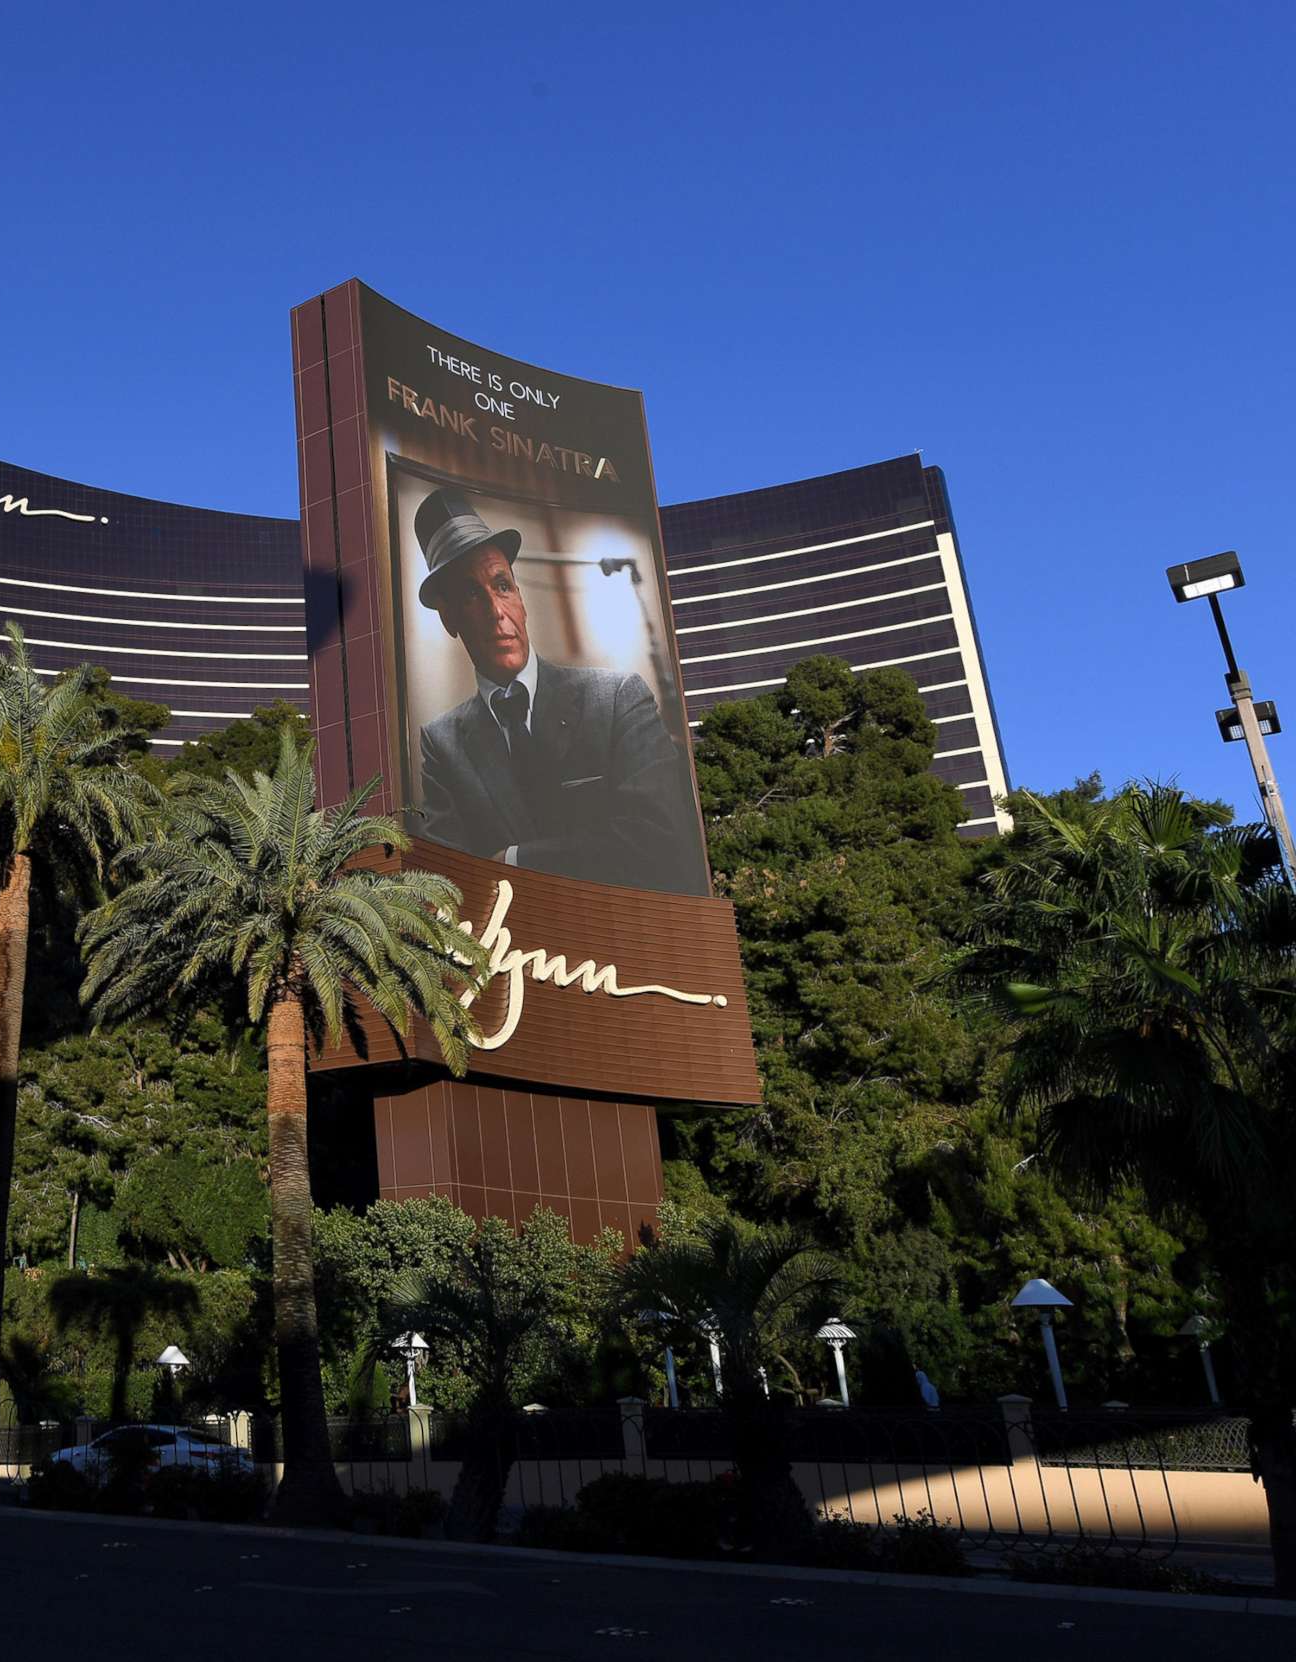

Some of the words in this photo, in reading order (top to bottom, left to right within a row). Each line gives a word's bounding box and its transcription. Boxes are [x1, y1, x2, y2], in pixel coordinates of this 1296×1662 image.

[426, 345, 482, 384] THERE
[488, 373, 503, 391] IS
[509, 382, 560, 409] ONLY
[474, 392, 516, 421] ONE
[387, 376, 479, 443] FRANK
[490, 426, 621, 483] SINATRA
